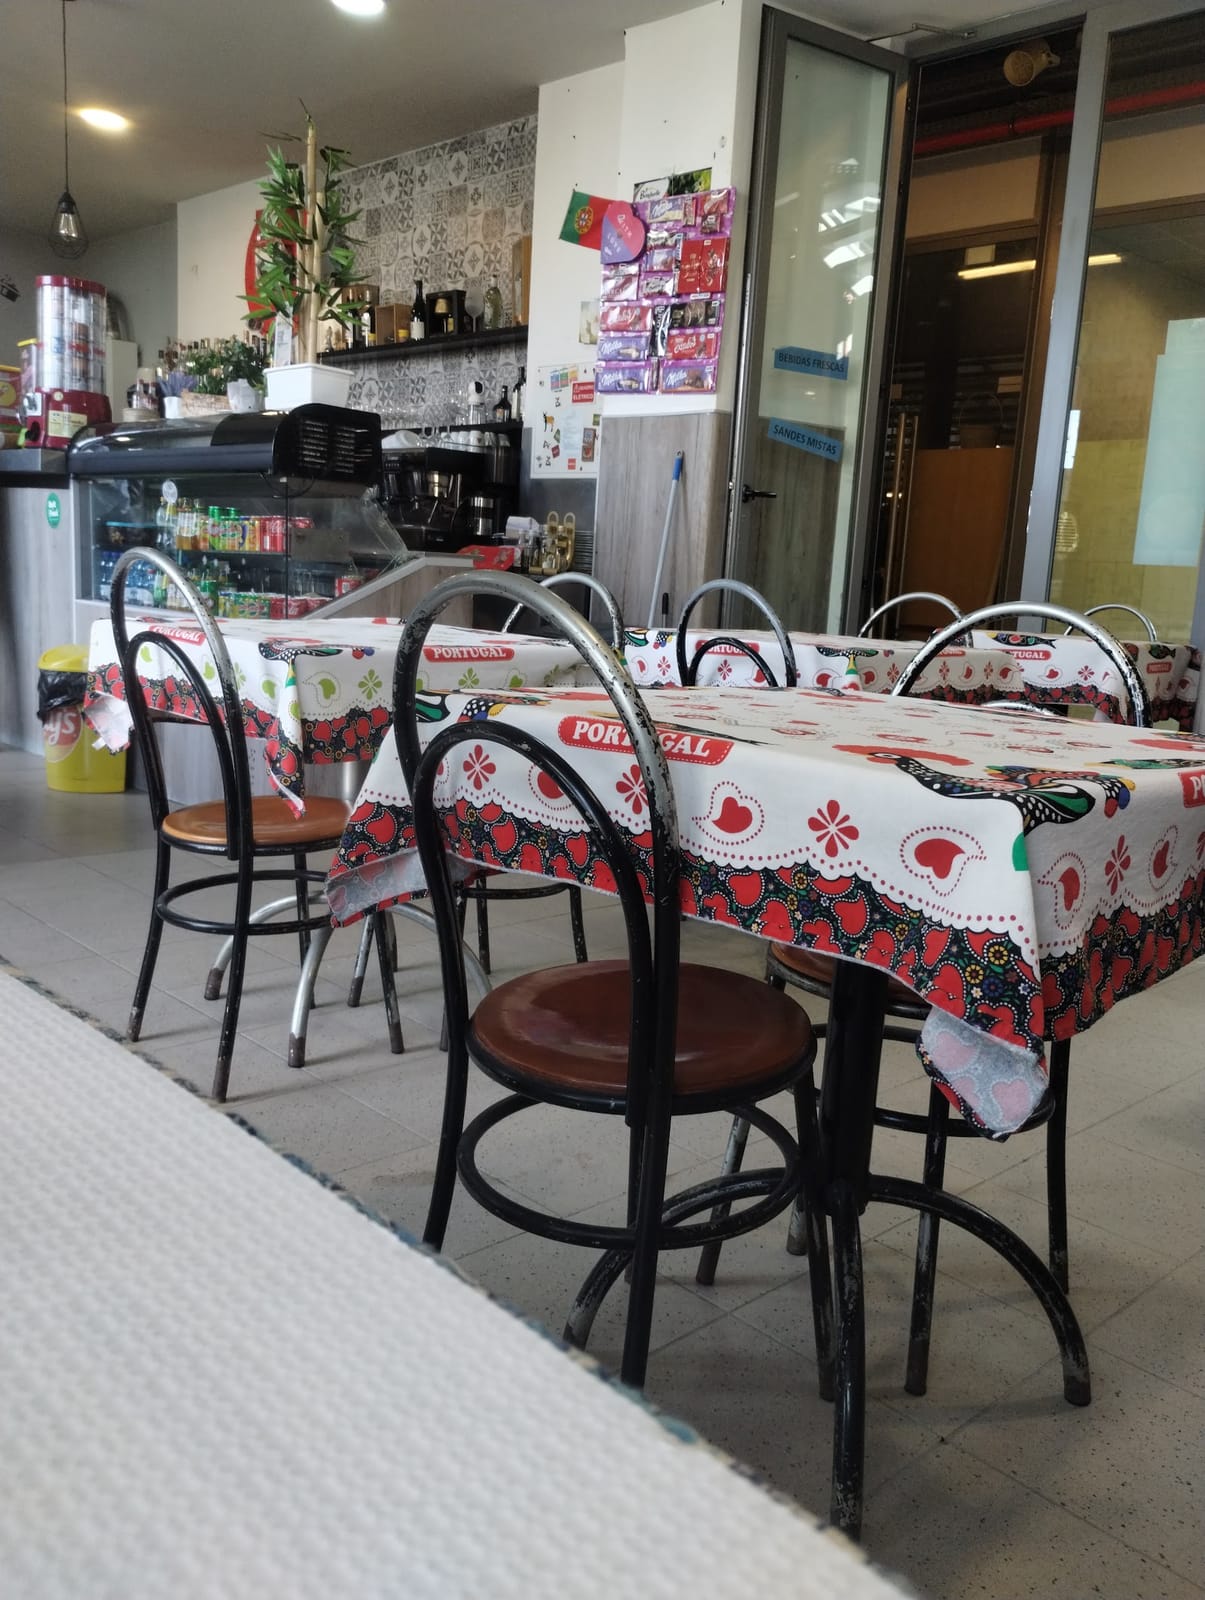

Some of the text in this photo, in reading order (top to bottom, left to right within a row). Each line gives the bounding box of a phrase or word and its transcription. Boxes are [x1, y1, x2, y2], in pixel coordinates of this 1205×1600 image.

[601, 341, 622, 355] Milka
[778, 352, 845, 373] BEBIDAS FRESCAS
[602, 371, 622, 386] Milka
[666, 369, 687, 386] Milka
[773, 424, 837, 455] SANDES MISTAS
[432, 646, 506, 659] PORTUGAL
[1011, 650, 1046, 659] TUGAL
[572, 720, 712, 757] PORTGAL
